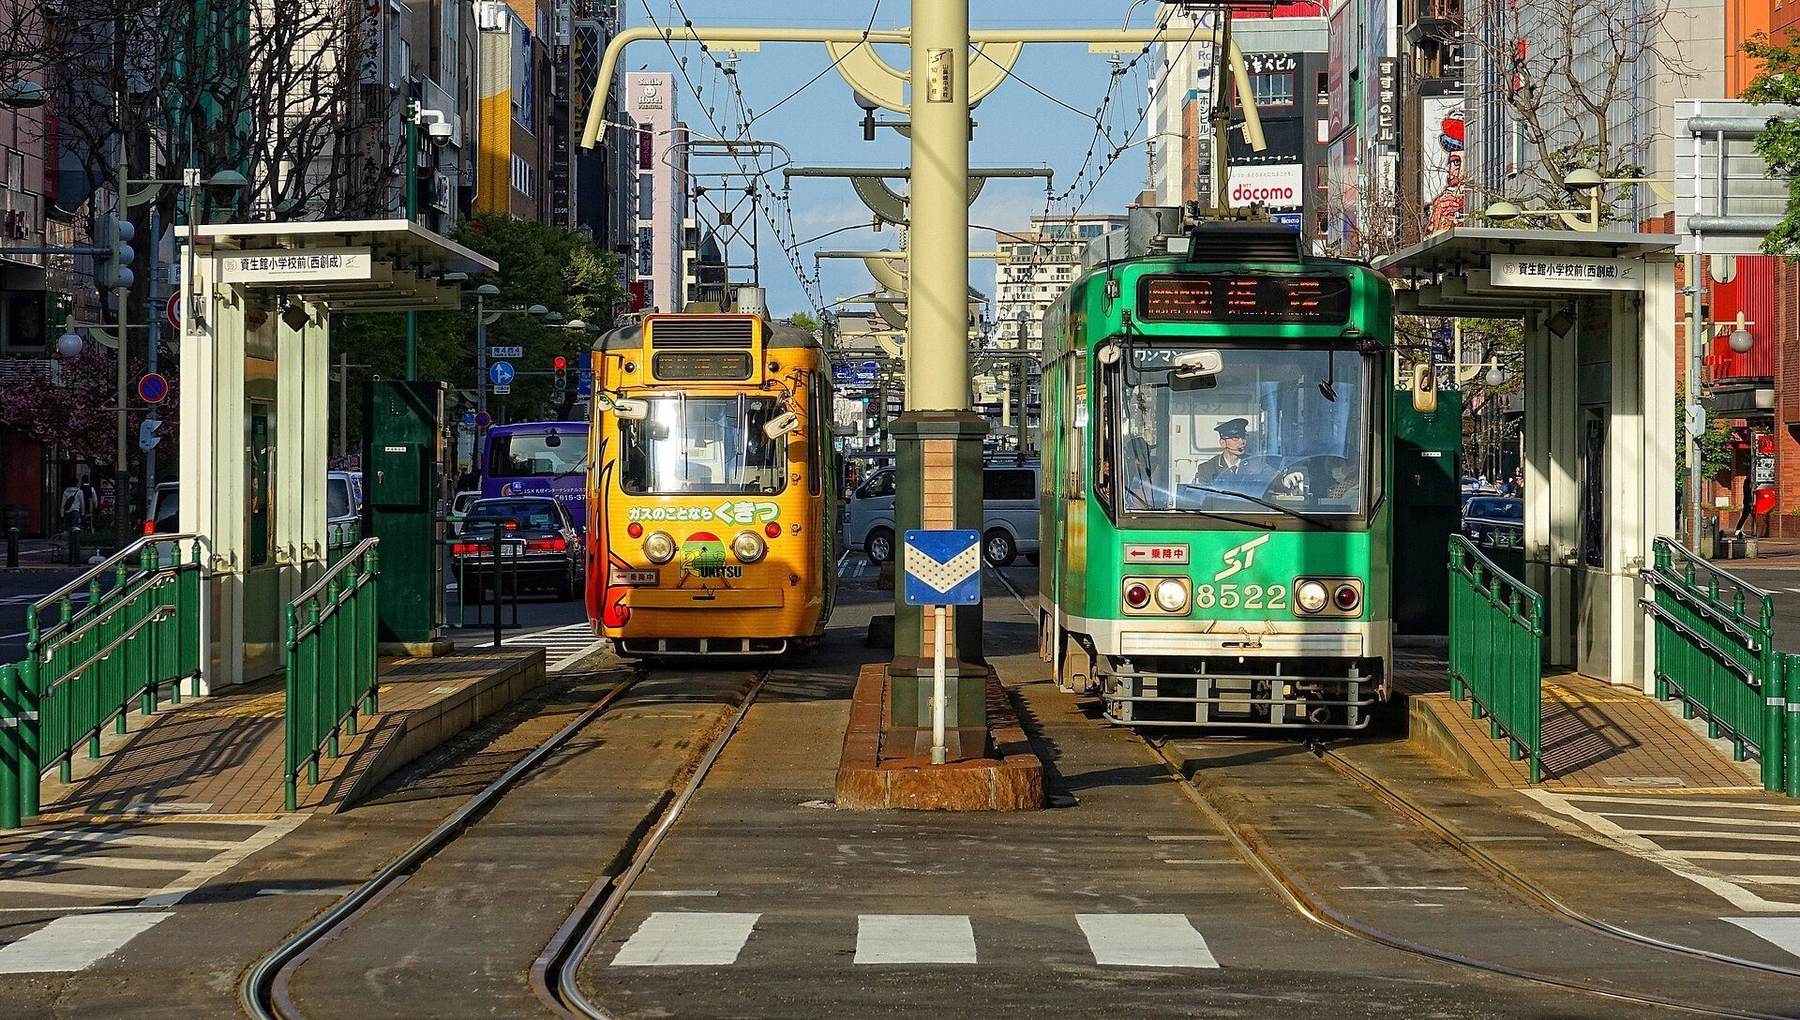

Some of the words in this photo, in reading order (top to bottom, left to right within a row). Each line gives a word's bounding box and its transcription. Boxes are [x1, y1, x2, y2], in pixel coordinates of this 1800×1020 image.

[638, 78, 662, 86] Smile
[638, 96, 662, 104] Hotel
[1379, 61, 1394, 141] すすきのビル
[1232, 184, 1293, 201] docomo
[240, 255, 342, 272] 資生館小学校前(西創成)
[1518, 262, 1618, 279] 資生館小学校前(西創成)
[629, 506, 713, 522] ガスのことなら
[714, 501, 781, 527] くきつ
[1151, 548, 1184, 559] 乗降中
[1214, 533, 1270, 582] ST
[1196, 584, 1287, 609] 8522
